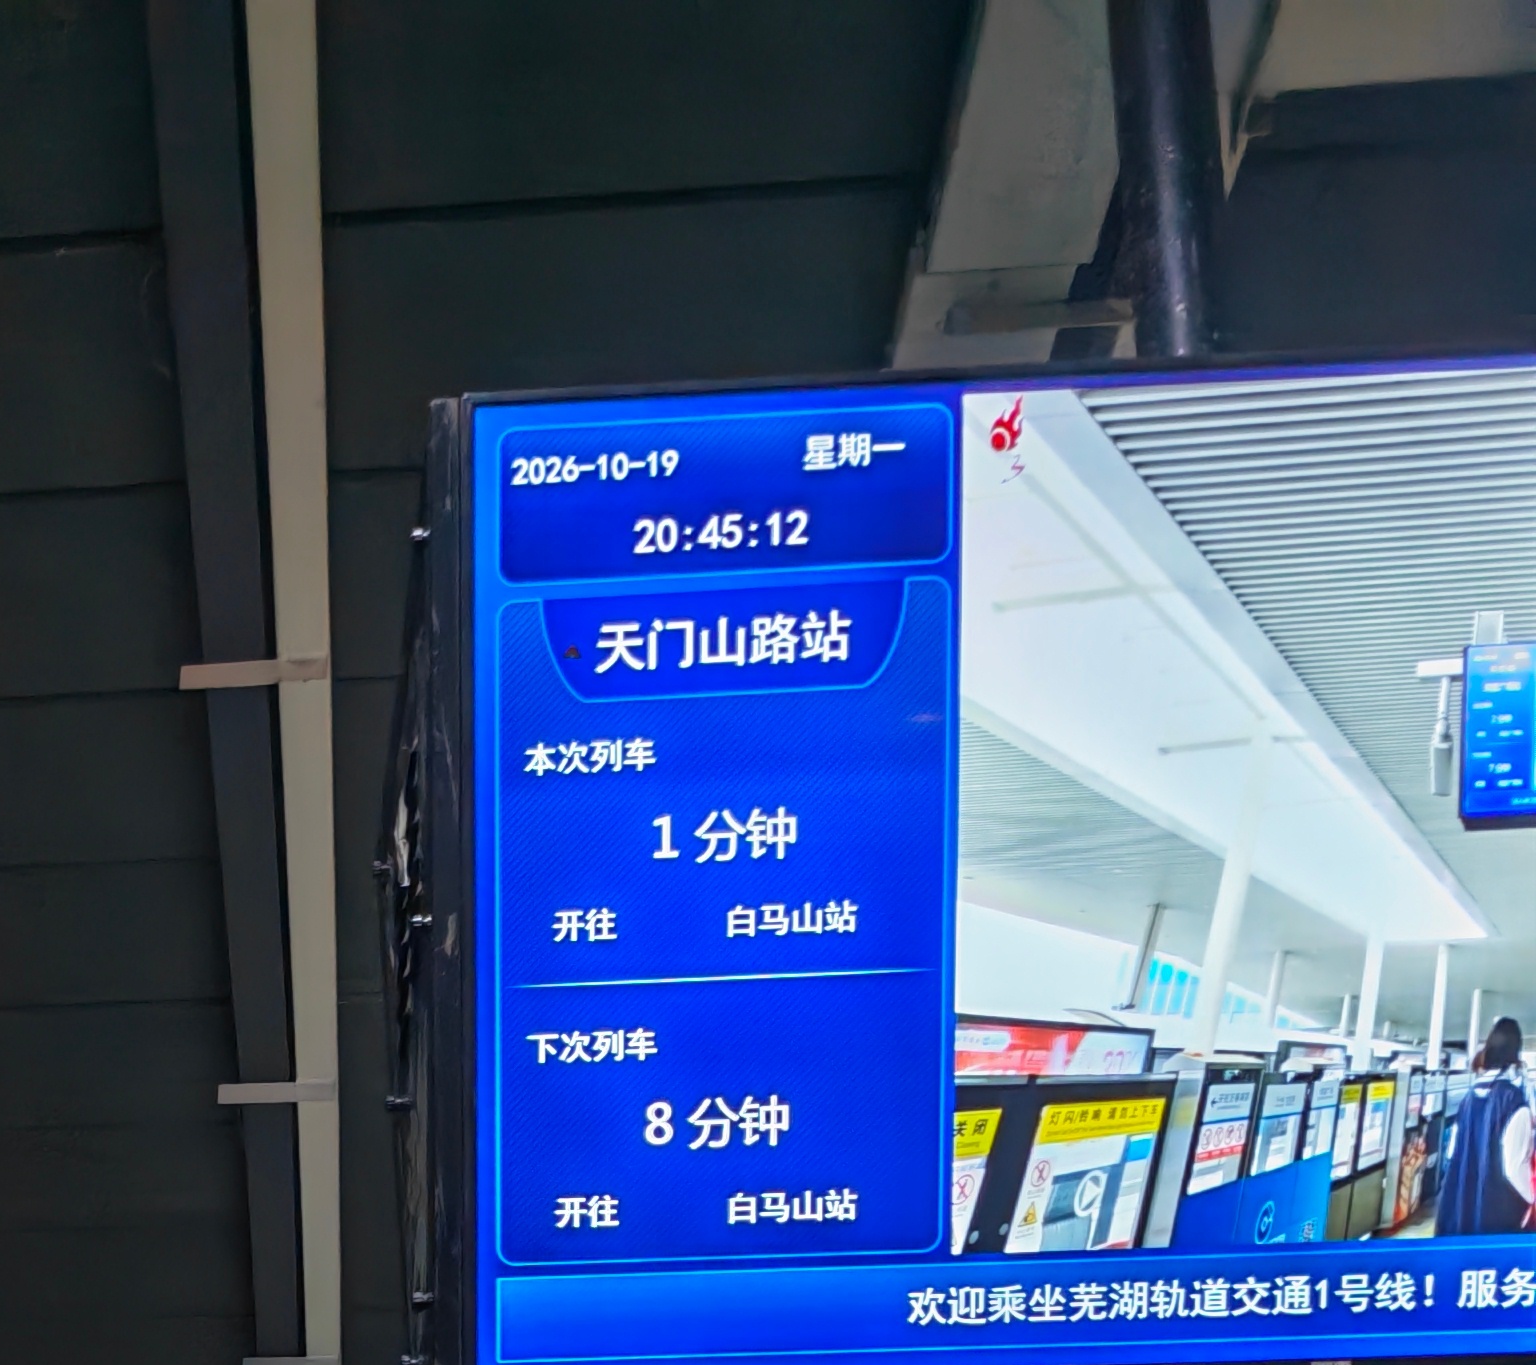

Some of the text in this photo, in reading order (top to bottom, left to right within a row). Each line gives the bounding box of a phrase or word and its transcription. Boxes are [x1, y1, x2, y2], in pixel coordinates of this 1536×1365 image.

[510, 449, 680, 486] 2026-10-19
[803, 432, 906, 471] 星期一
[633, 510, 810, 554] 20:45:12
[594, 609, 852, 674] 天门山路站
[524, 737, 657, 776] 本次列车
[651, 806, 798, 863] 1 分钟
[552, 900, 858, 942] 开往 白马山站
[525, 1028, 658, 1064] 下次列车
[644, 1094, 790, 1150] 8 分钟
[554, 1187, 859, 1228] 开往 白马山站
